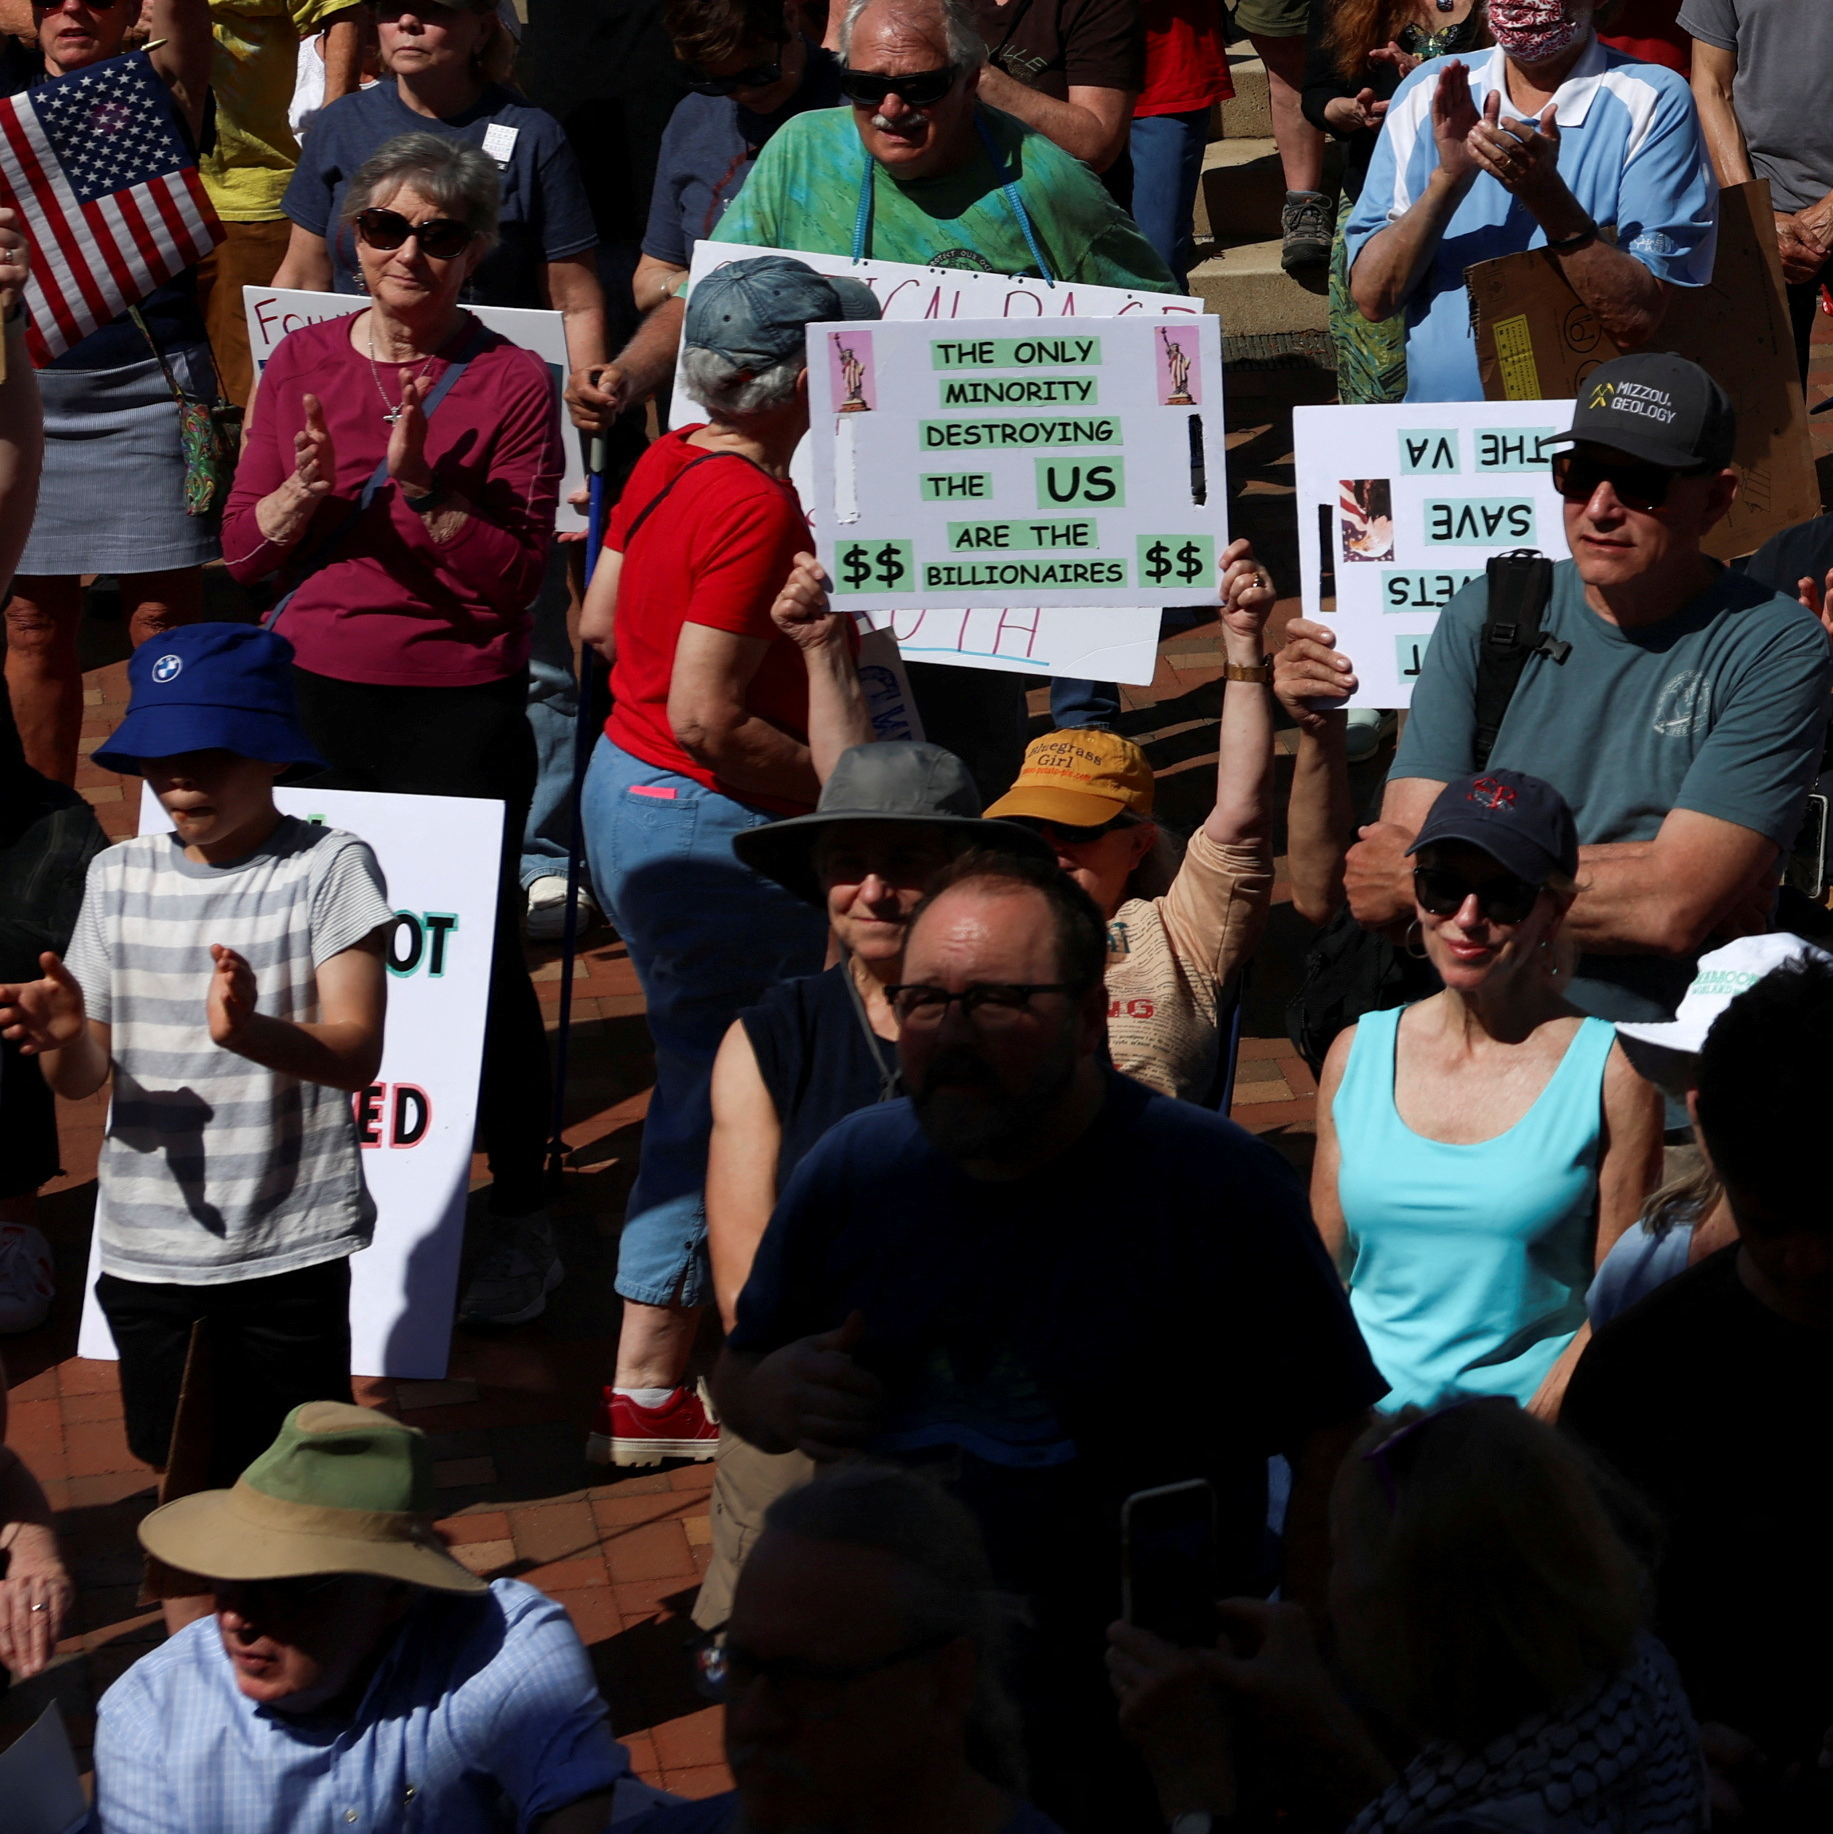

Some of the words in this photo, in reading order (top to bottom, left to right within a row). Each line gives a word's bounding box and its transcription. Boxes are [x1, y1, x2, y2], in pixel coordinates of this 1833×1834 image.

[937, 342, 994, 363] THE
[1015, 341, 1093, 363] ONLY
[946, 381, 1092, 403] MINORITY
[927, 421, 1113, 446] DESTROYING
[927, 475, 984, 496] THE
[1048, 466, 1115, 502] US
[928, 563, 1122, 586] BILLIONAIRES
